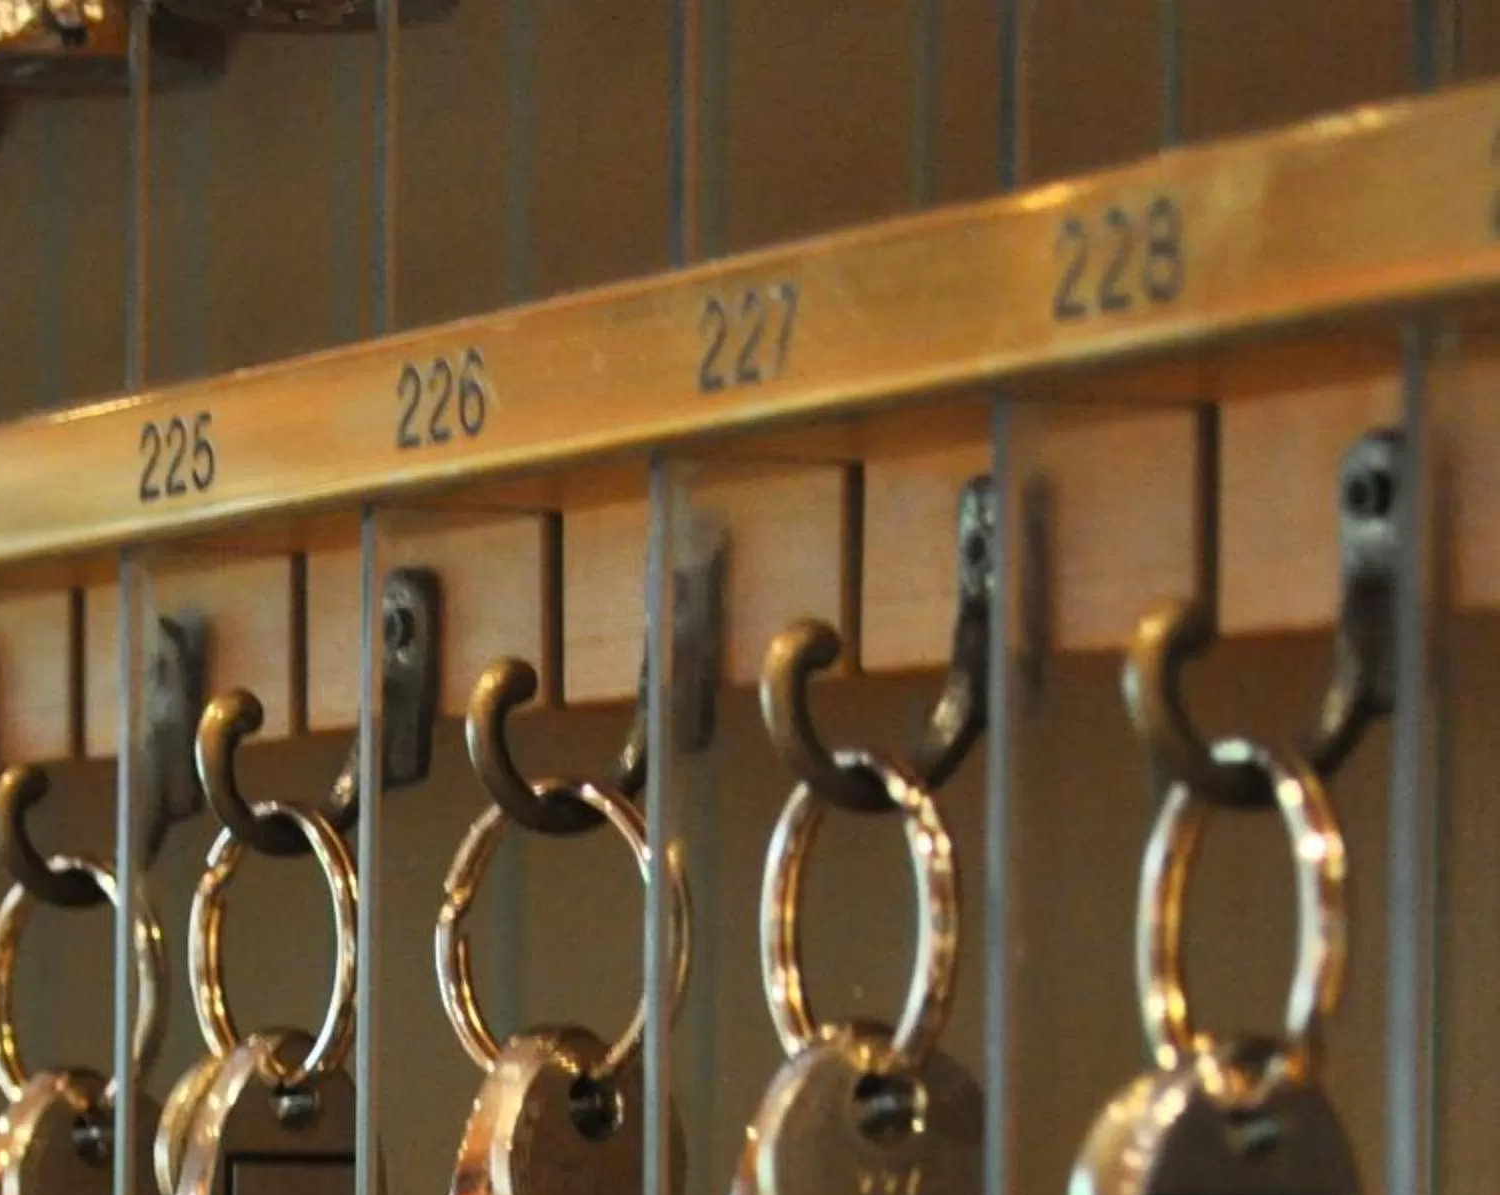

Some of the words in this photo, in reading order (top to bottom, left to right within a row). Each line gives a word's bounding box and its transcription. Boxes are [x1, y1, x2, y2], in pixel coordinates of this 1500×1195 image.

[1052, 195, 1186, 322] 228
[697, 283, 799, 393] 227
[395, 347, 487, 450] 226
[138, 410, 216, 501] 225
